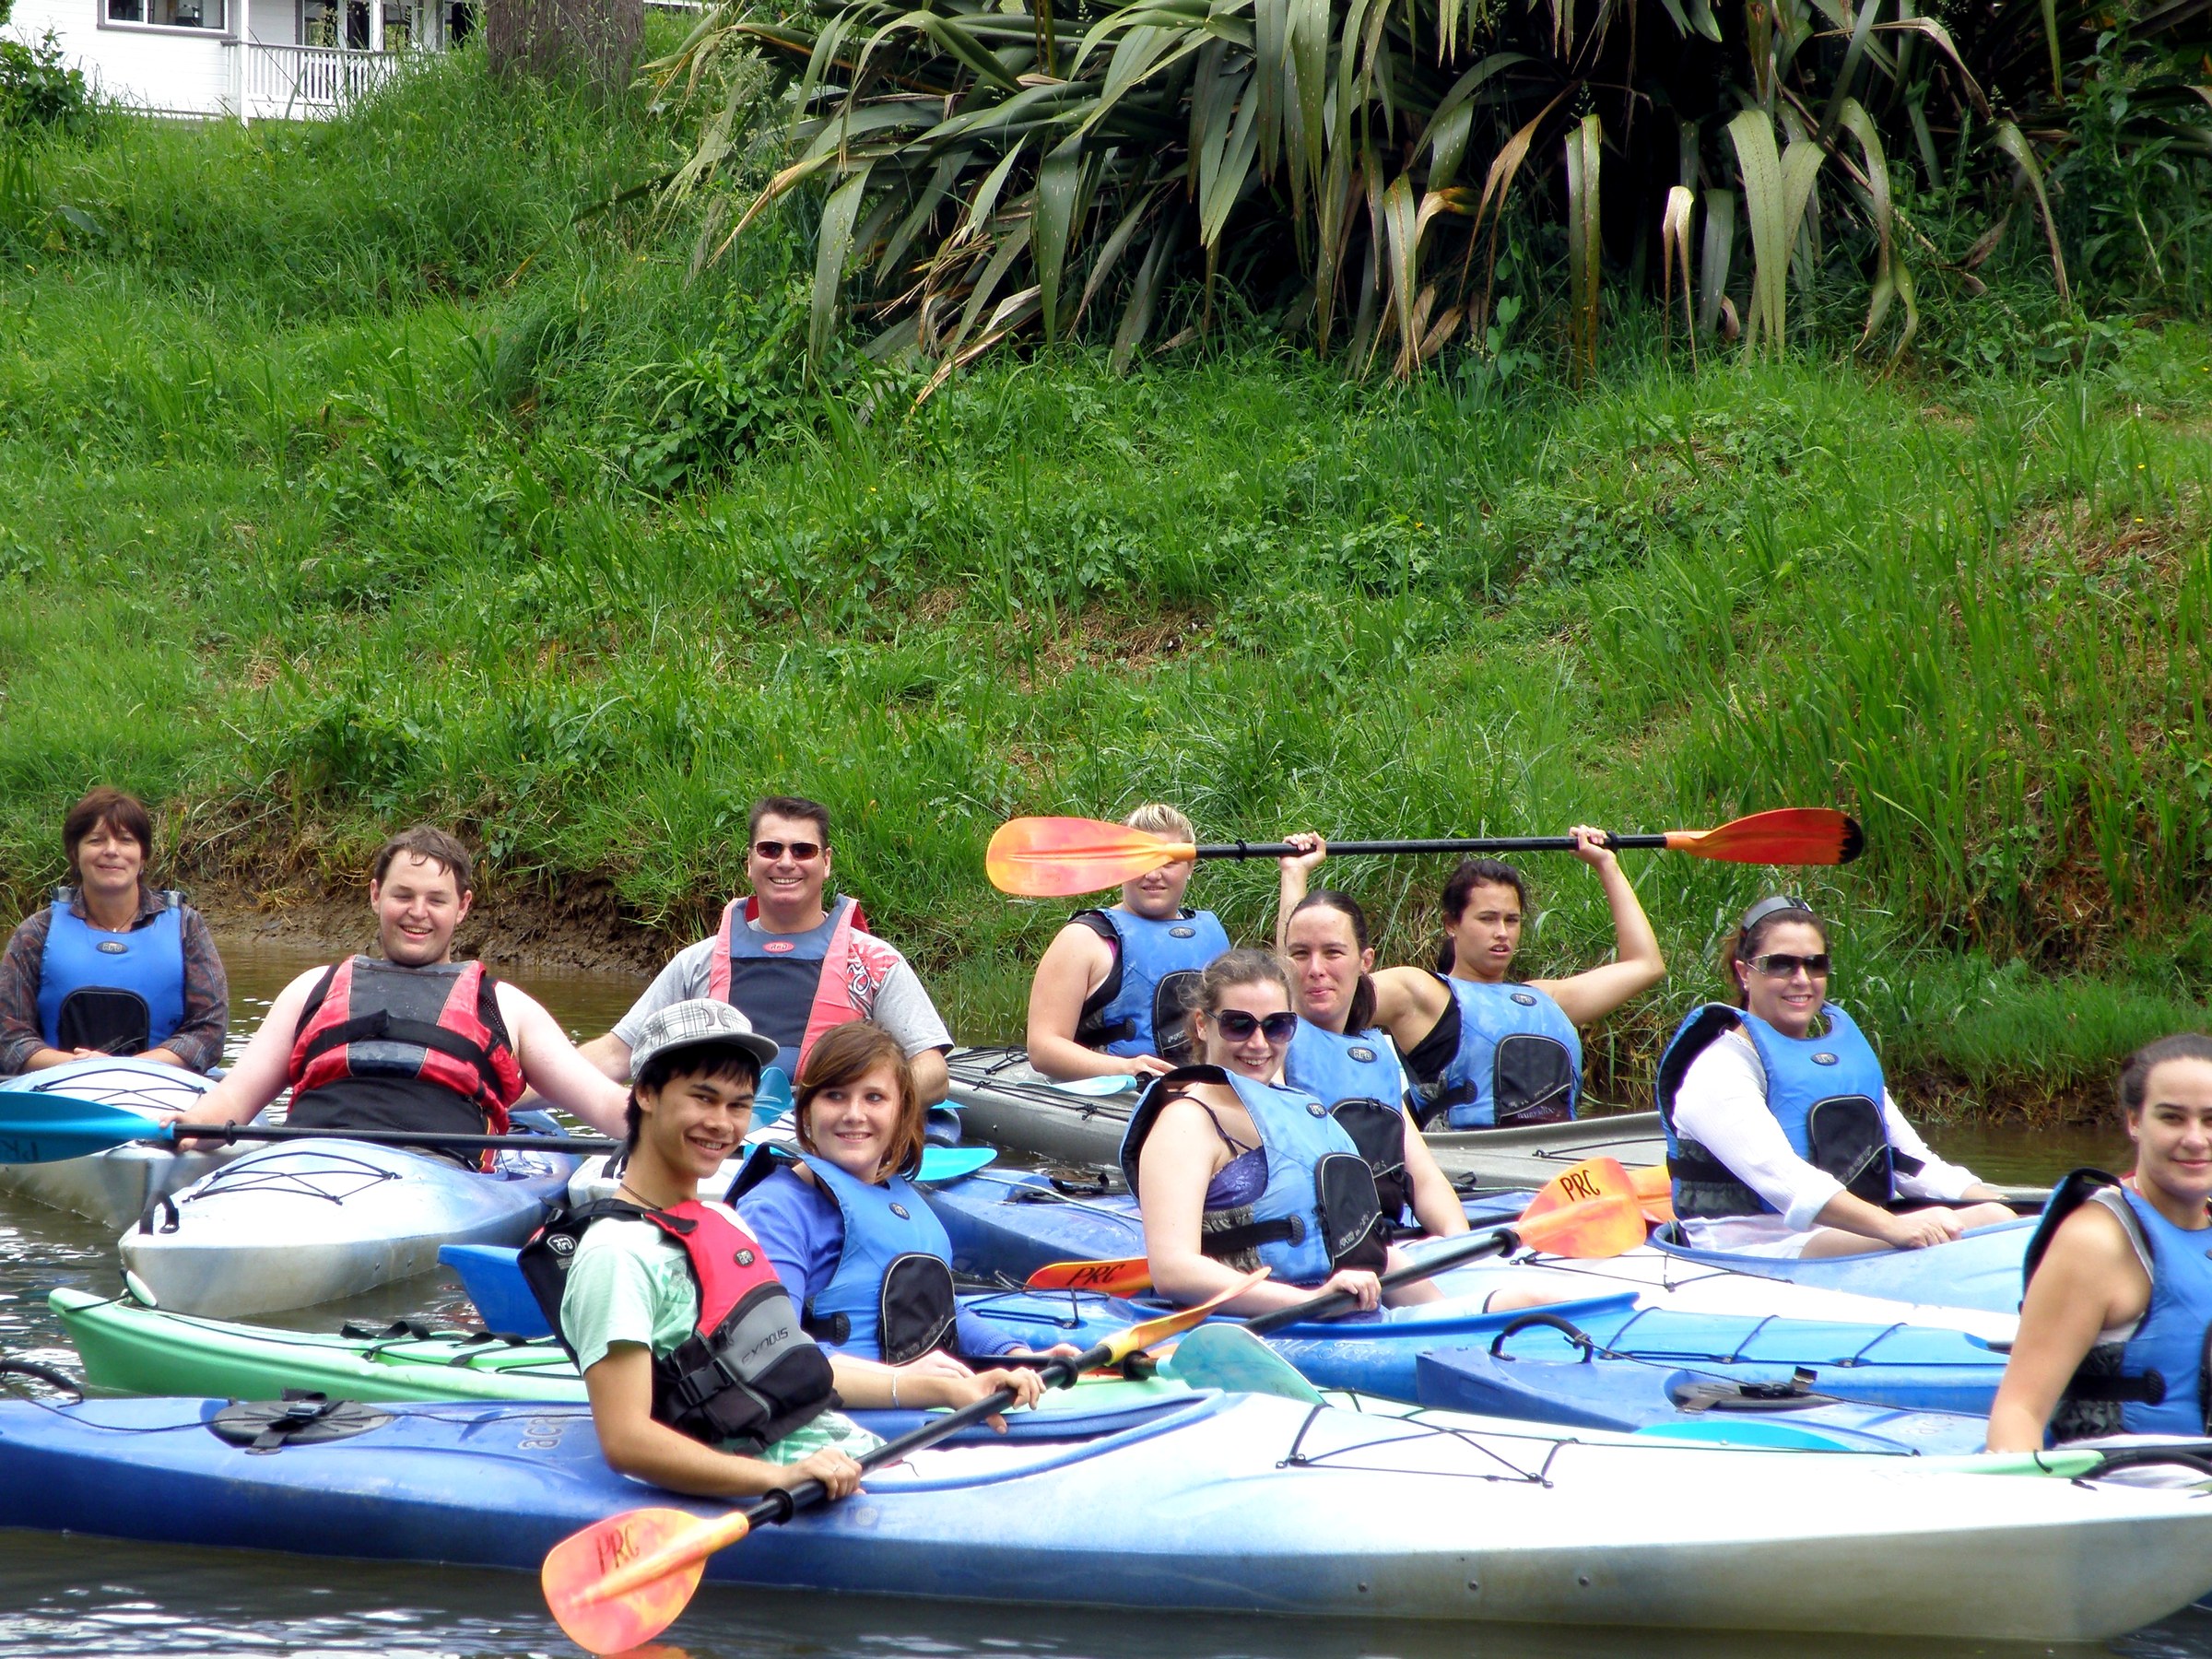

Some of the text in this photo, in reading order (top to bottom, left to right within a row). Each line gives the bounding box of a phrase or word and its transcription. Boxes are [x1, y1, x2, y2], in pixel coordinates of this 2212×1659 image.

[1559, 1169, 1601, 1202] PRC
[553, 1237, 573, 1251] RFD
[1066, 1263, 1126, 1287] PRC
[596, 1524, 641, 1576] PRC
